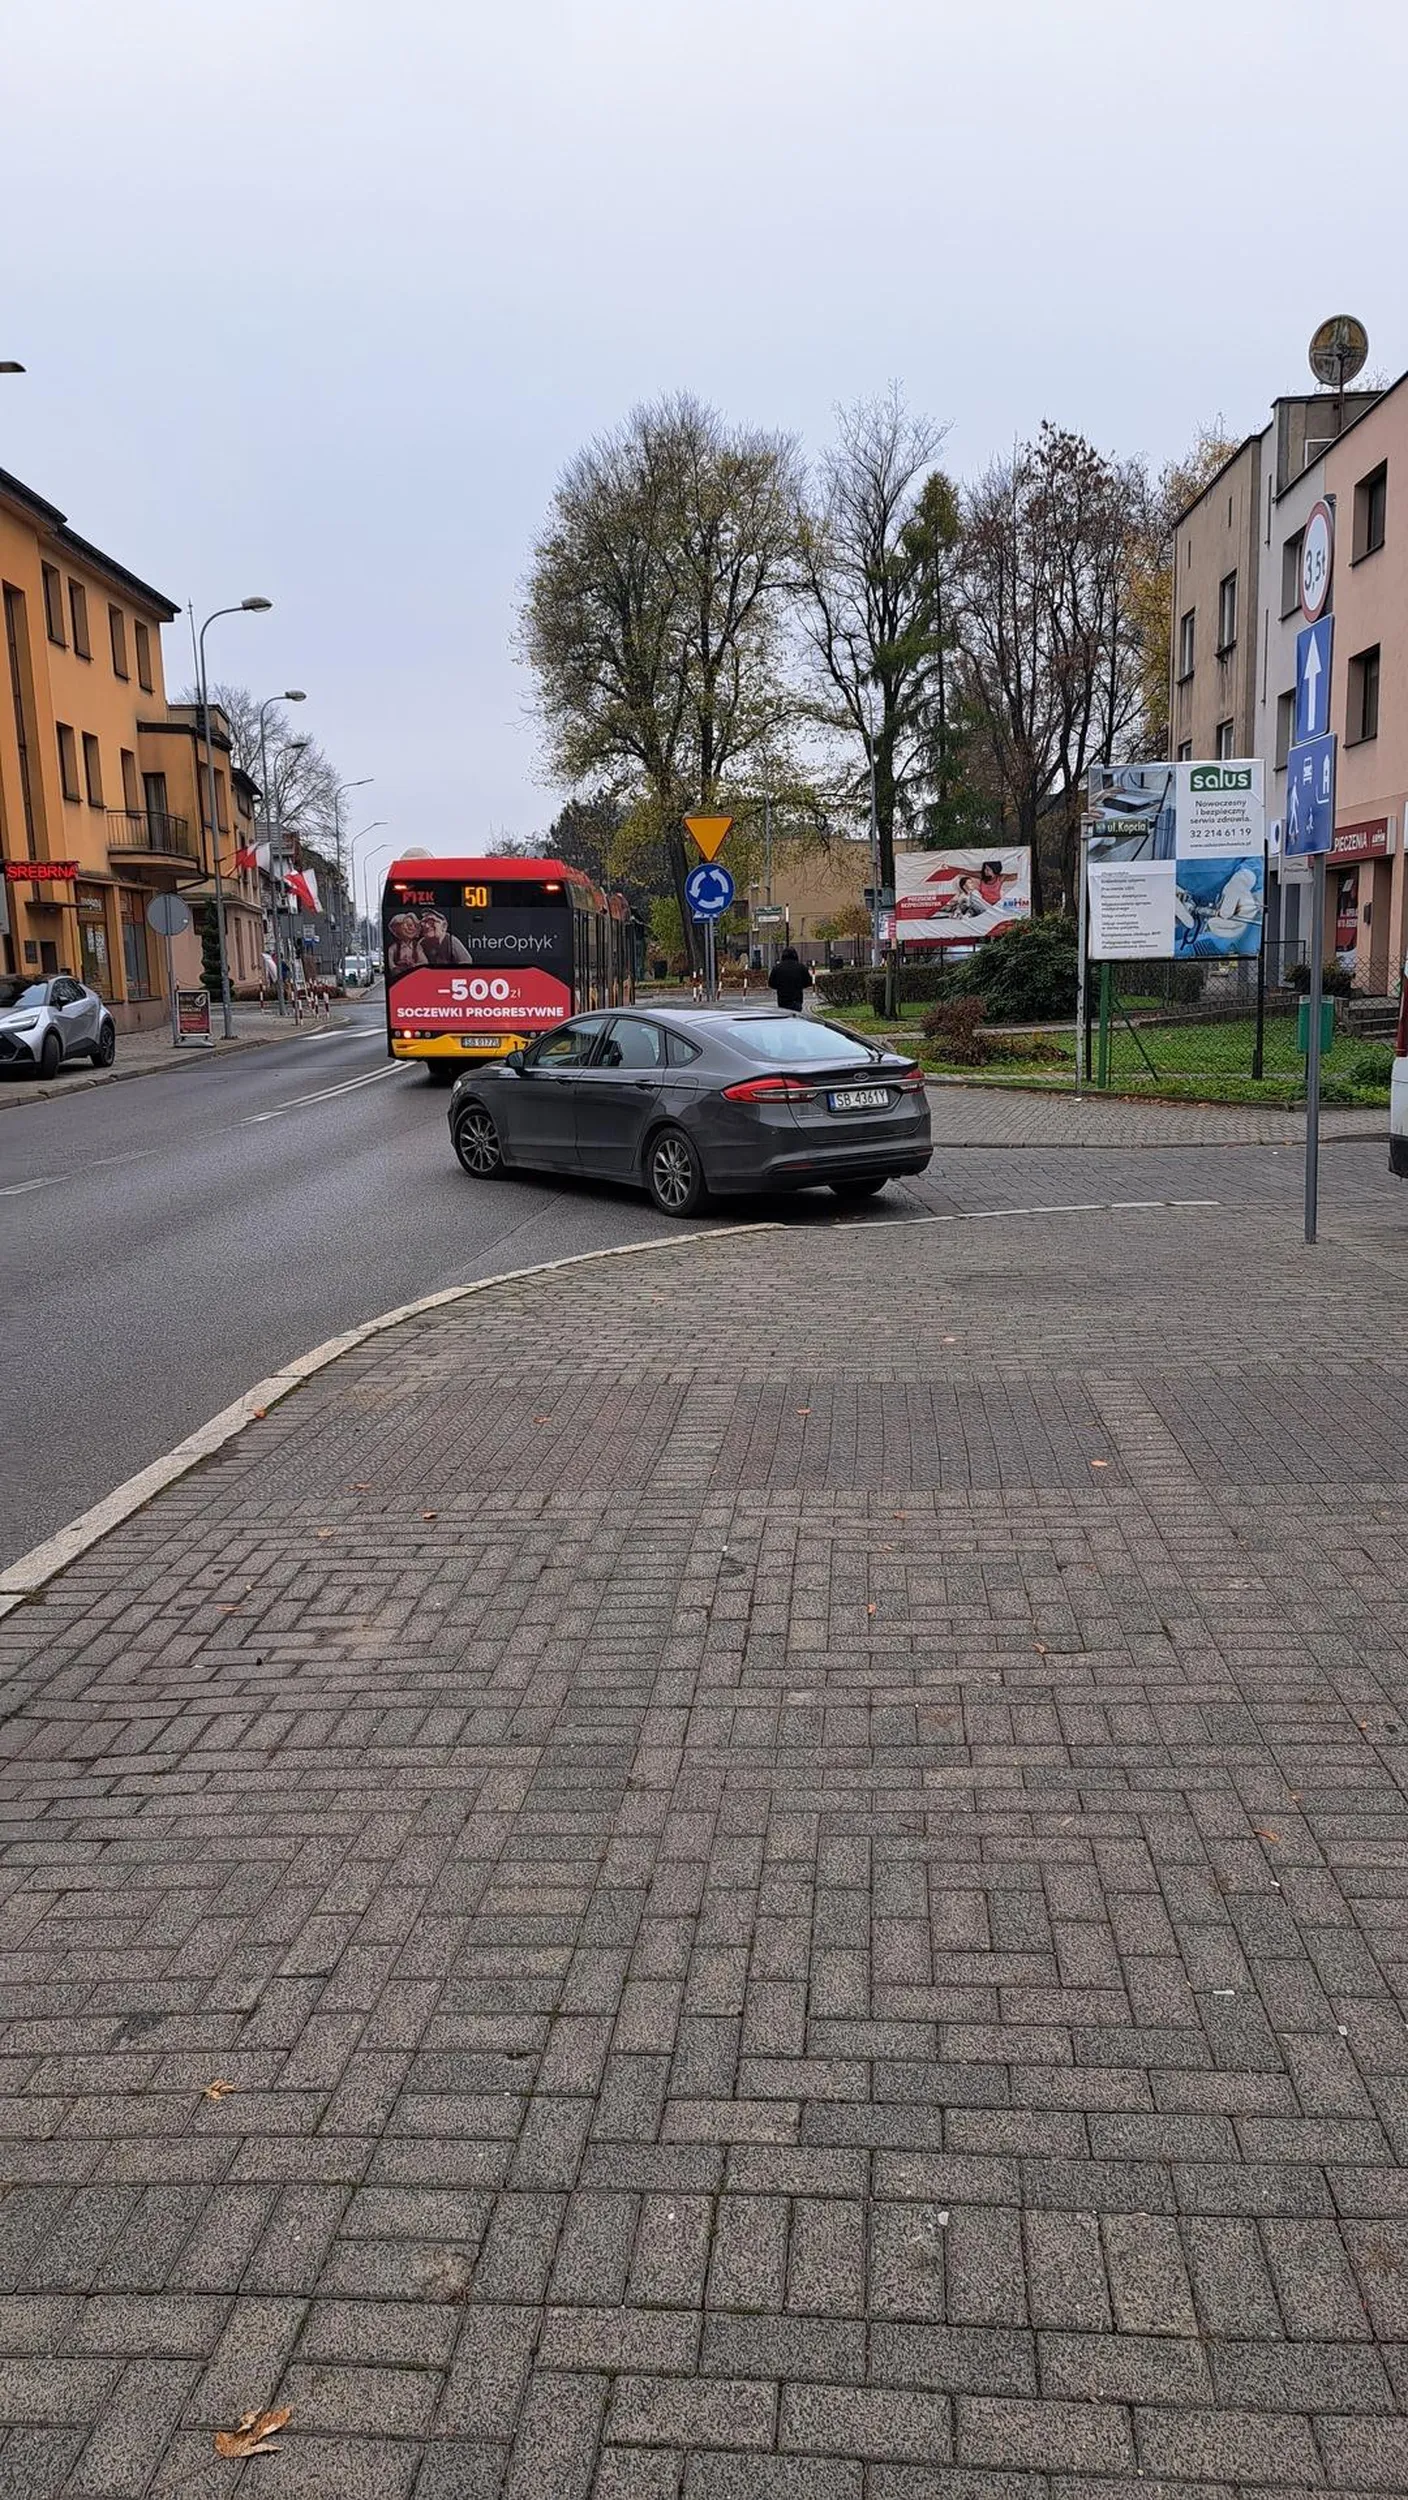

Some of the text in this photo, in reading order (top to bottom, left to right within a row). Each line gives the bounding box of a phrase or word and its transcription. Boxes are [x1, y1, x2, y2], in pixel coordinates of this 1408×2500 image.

[1304, 548, 1326, 593] 3,5t
[1193, 766, 1249, 789] salus
[1195, 800, 1247, 808] Nowoczesny
[1201, 808, 1246, 817] bezpieczny
[1190, 817, 1215, 825] serwis
[1190, 828, 1252, 838] 32 214 61 19
[7, 865, 78, 879] SREBRNA
[464, 886, 488, 908] 50
[468, 934, 553, 953] interOptyk
[510, 988, 522, 999] zł
[396, 1007, 564, 1018] SOCZEWKI PROGRESYWNE
[836, 1090, 886, 1107] SB 4361Y
